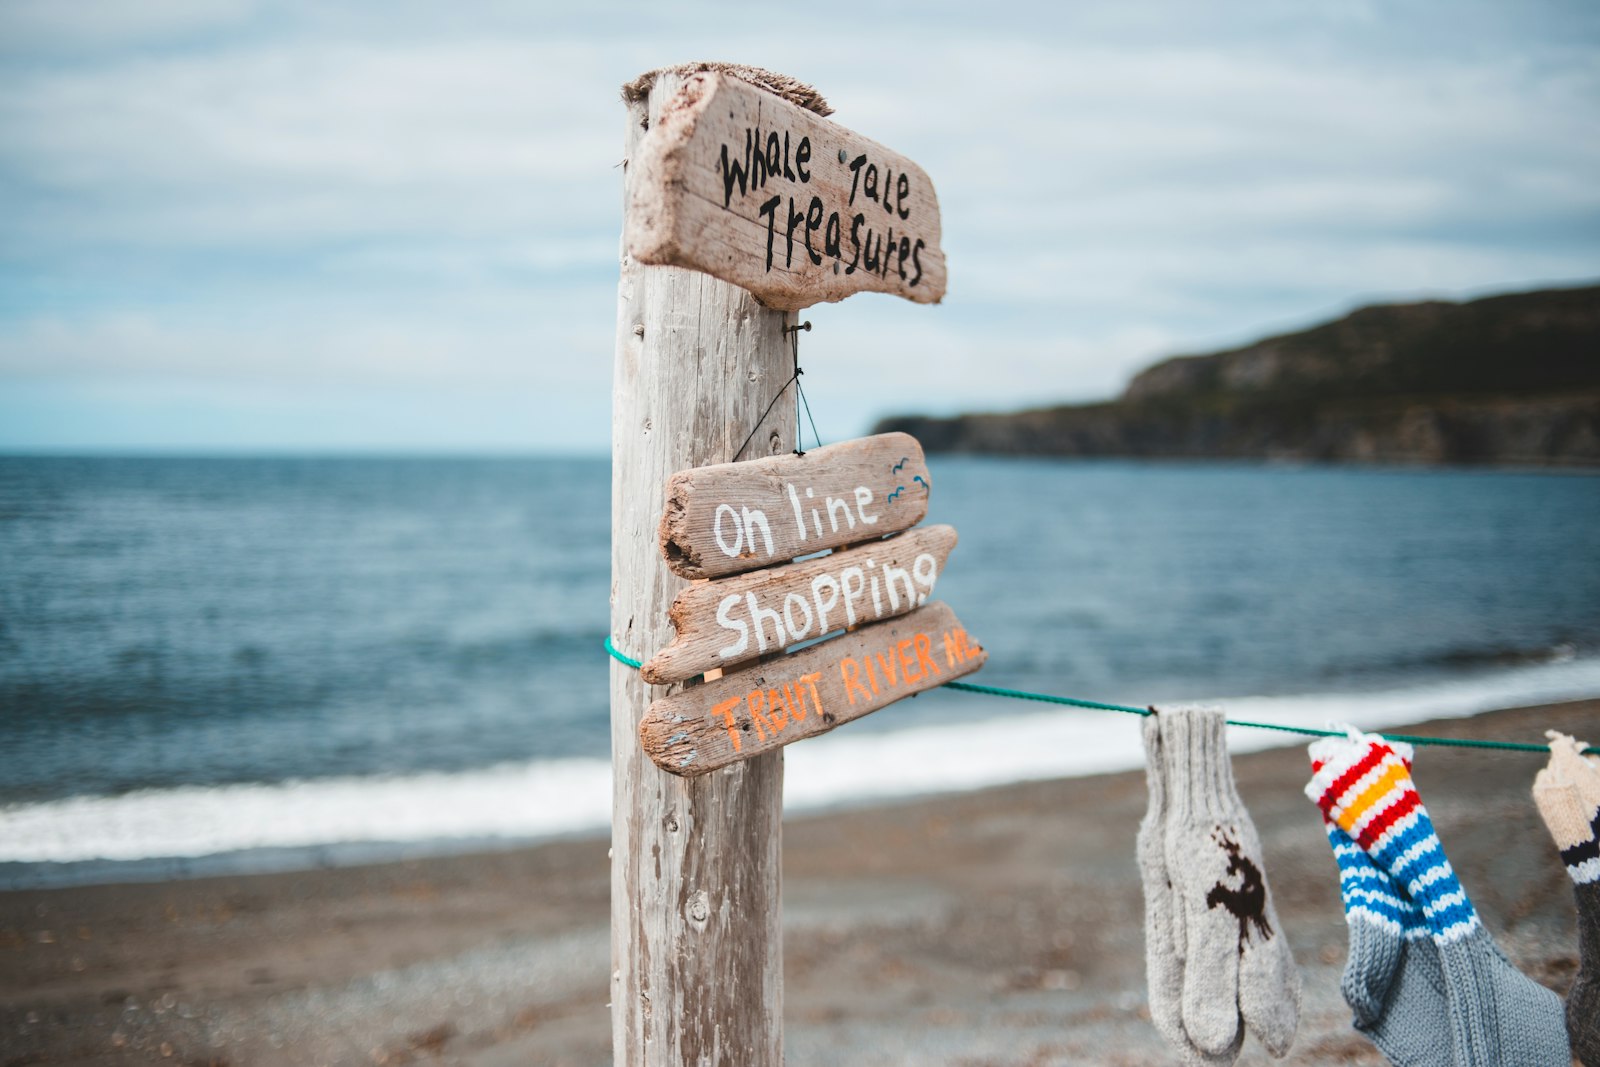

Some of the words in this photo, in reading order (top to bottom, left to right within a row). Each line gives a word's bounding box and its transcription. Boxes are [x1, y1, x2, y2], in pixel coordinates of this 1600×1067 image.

[759, 195, 925, 287] Treasures
[787, 483, 878, 541] line
[716, 553, 938, 659] Shopping
[711, 671, 823, 753] TROUT
[840, 633, 941, 705] RIVER
